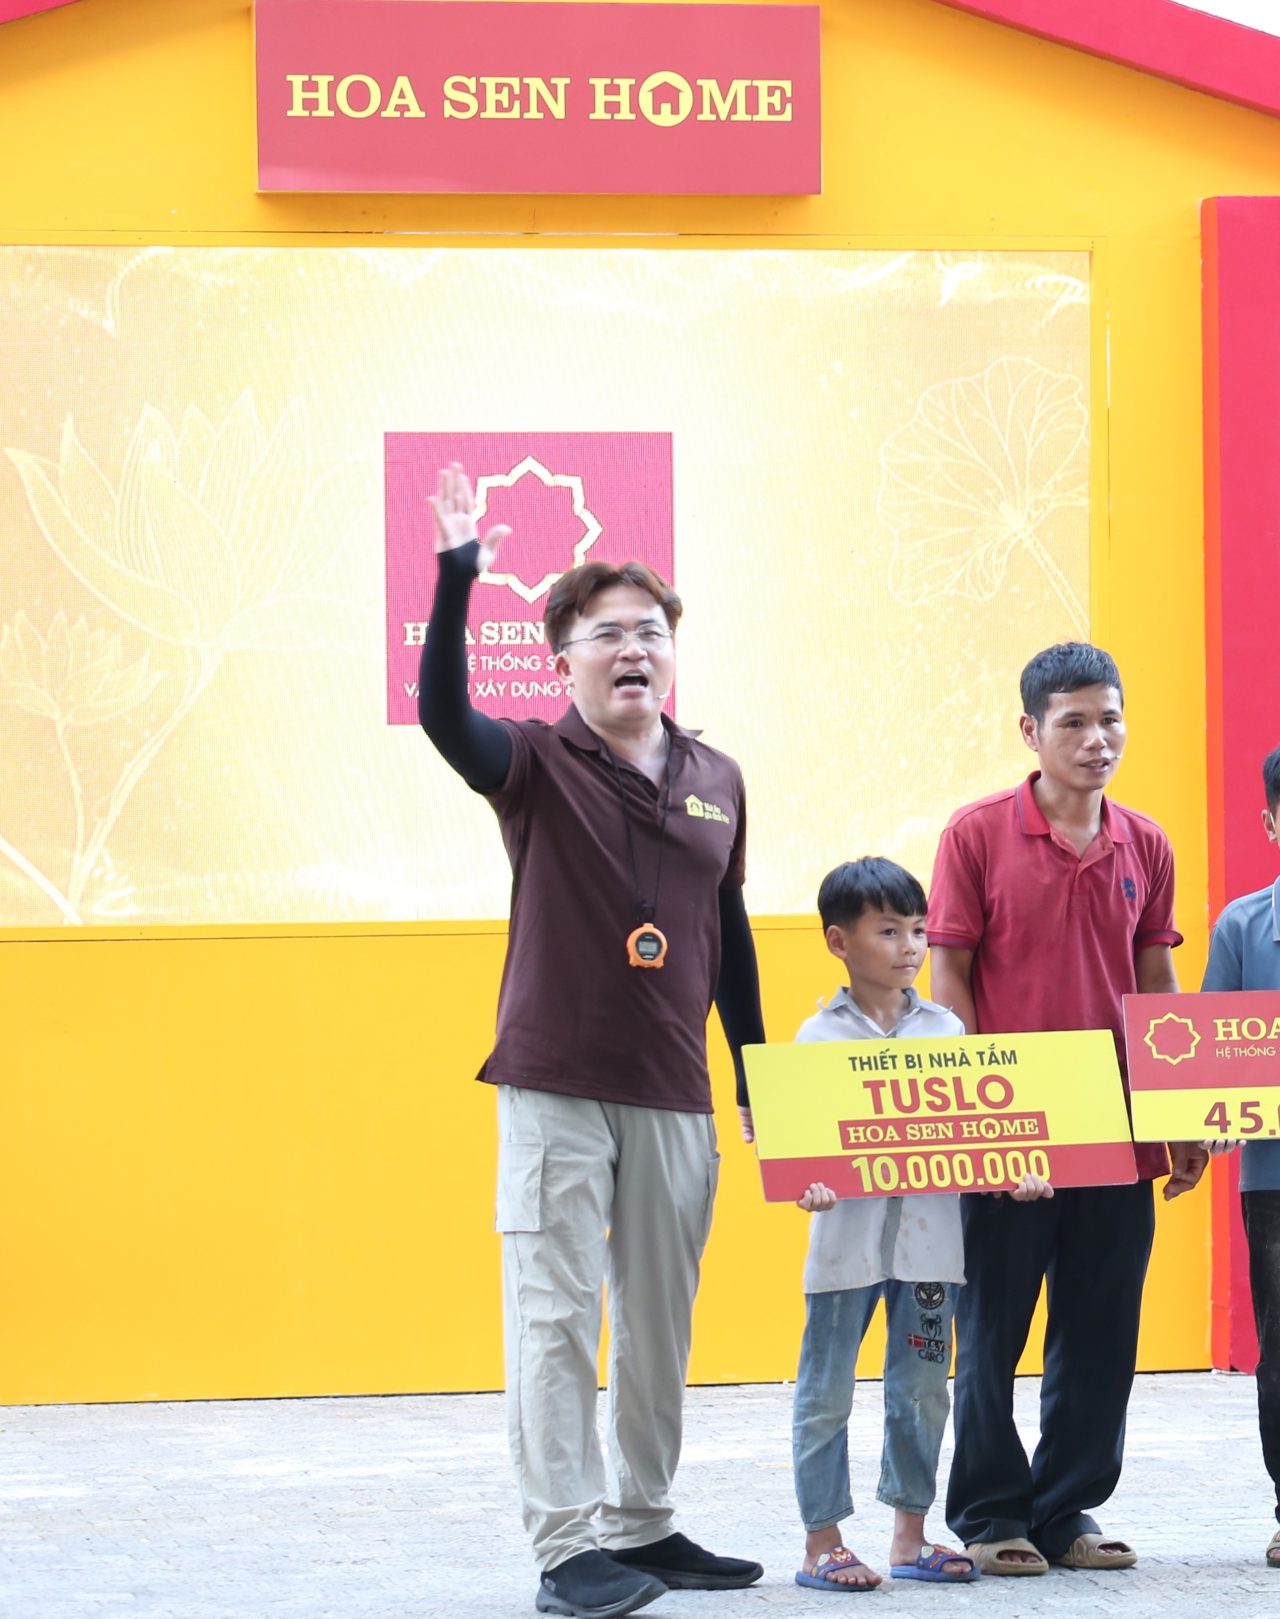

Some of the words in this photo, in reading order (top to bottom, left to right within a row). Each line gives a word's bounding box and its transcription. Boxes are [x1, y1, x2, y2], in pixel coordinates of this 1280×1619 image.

[286, 73, 426, 119] HOA
[442, 75, 571, 120] SEN
[588, 70, 793, 127] HOME
[480, 621, 545, 645] SEN
[475, 678, 507, 697] XÂY
[511, 680, 562, 699] DỰNG
[848, 1048, 898, 1072] THIẾT
[904, 1053, 924, 1074] BỊ
[928, 1047, 972, 1068] NHÀ
[976, 1043, 1018, 1066] TẮM
[1215, 1045, 1231, 1059] HỆ
[1233, 1044, 1277, 1057] THỐNG
[862, 1074, 1014, 1115] TUSLO
[846, 1125, 901, 1144] HOA
[905, 1122, 954, 1141] SEN
[960, 1117, 1039, 1139] HOME
[851, 1149, 1051, 1193] 10.000.000
